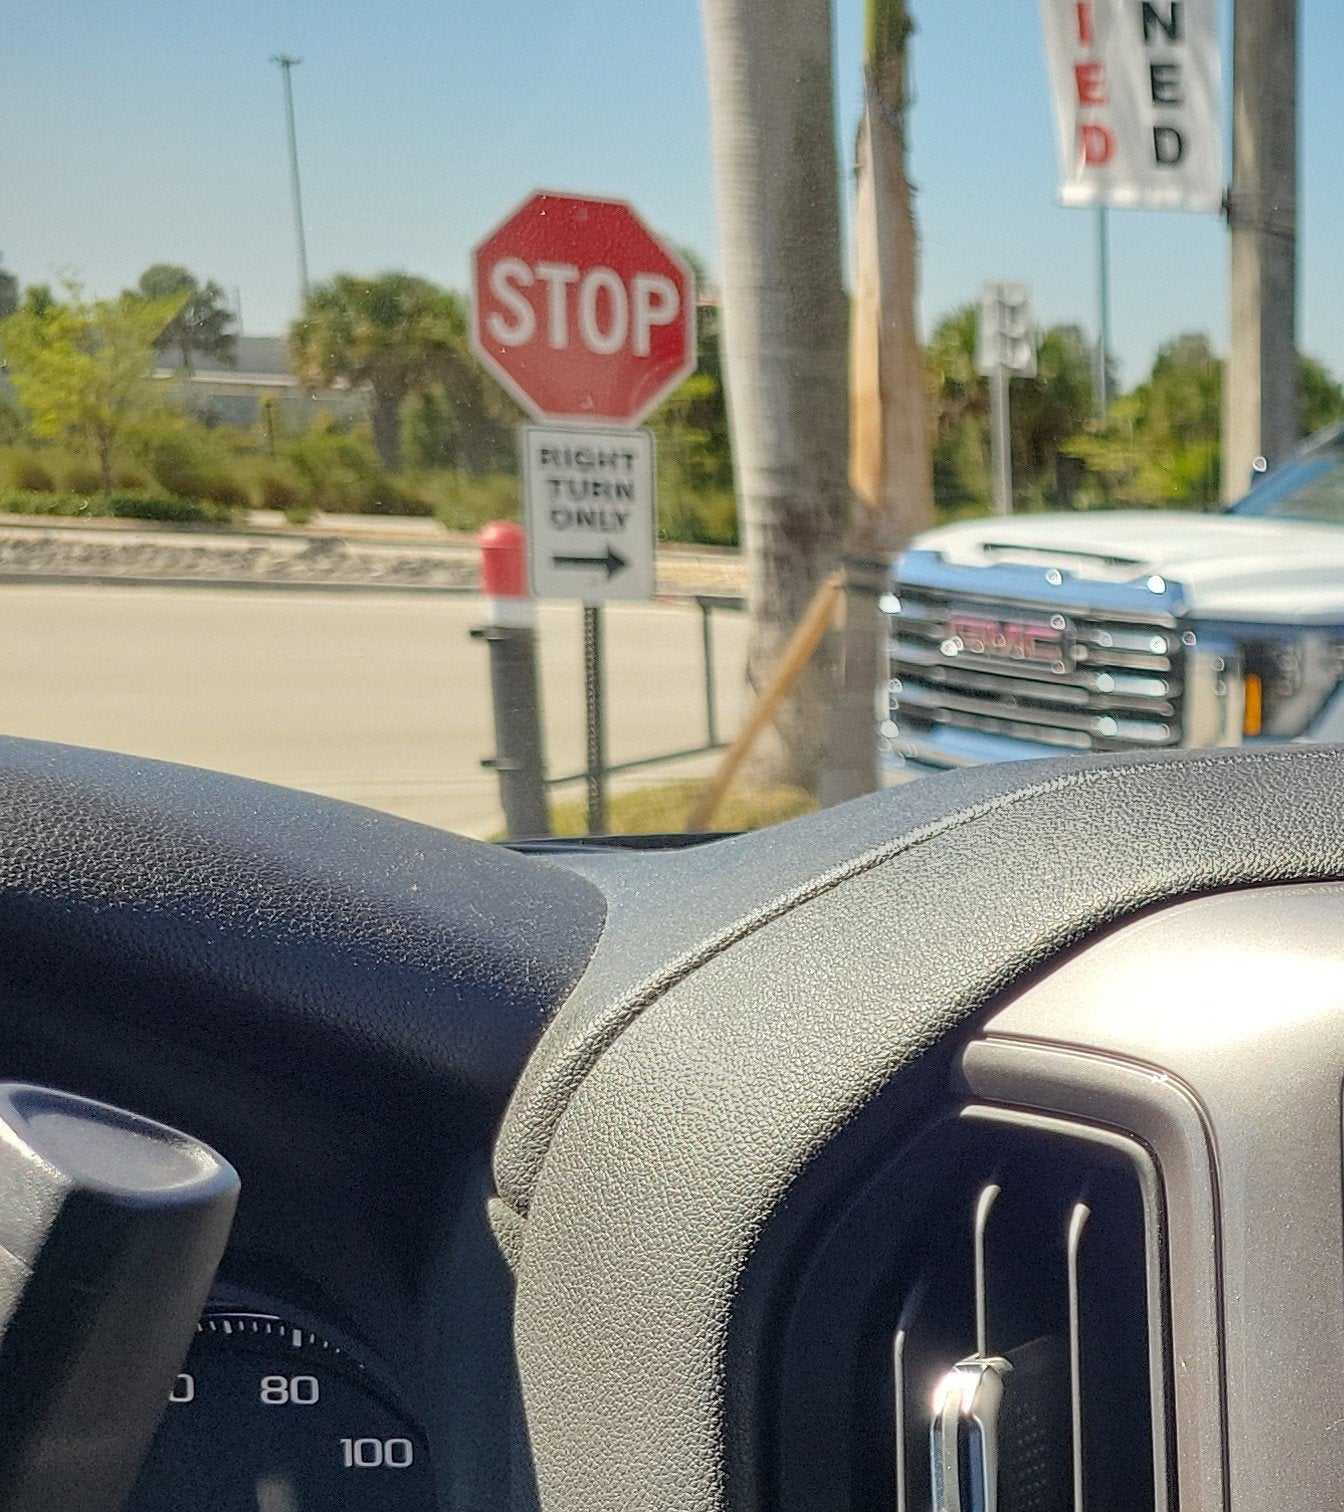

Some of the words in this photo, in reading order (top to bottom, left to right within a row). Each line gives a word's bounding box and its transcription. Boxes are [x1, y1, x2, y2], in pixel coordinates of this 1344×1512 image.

[486, 256, 681, 357] STOP
[540, 447, 635, 473] RIGHT
[546, 477, 635, 501] TURN
[550, 507, 631, 531] ONLY
[168, 1373, 195, 1402] 0
[260, 1375, 320, 1404] 80
[340, 1437, 414, 1468] 100
